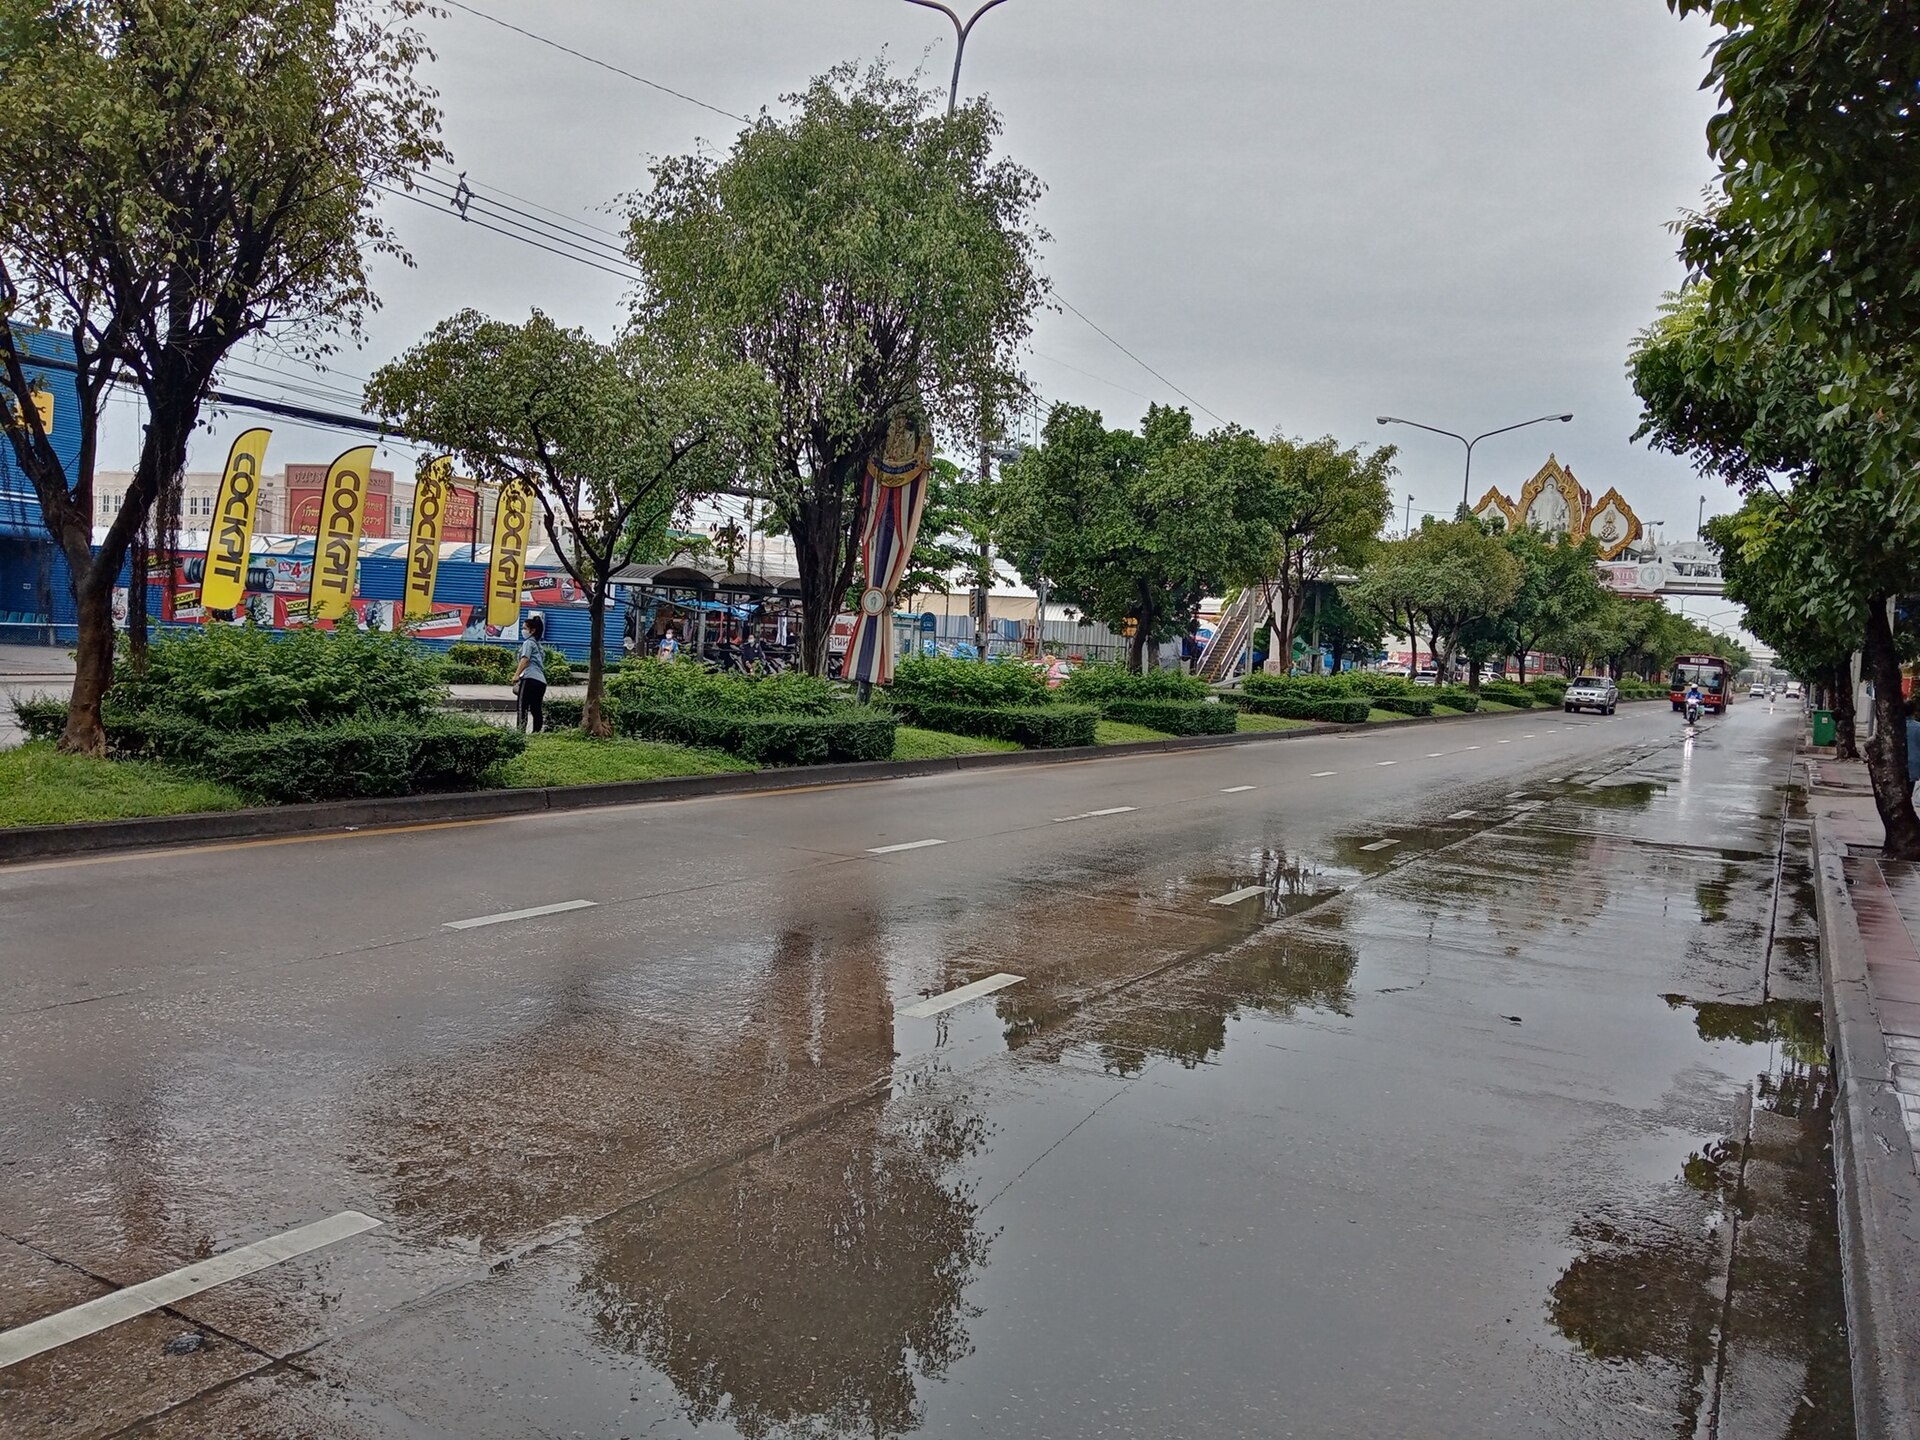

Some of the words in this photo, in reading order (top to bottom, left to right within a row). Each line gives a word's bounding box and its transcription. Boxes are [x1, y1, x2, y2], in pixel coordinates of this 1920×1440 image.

[214, 453, 255, 583] COCKPIT
[321, 470, 360, 594] COCKPIT
[411, 480, 441, 597] COCKPIT
[495, 492, 526, 603] COCKPIT
